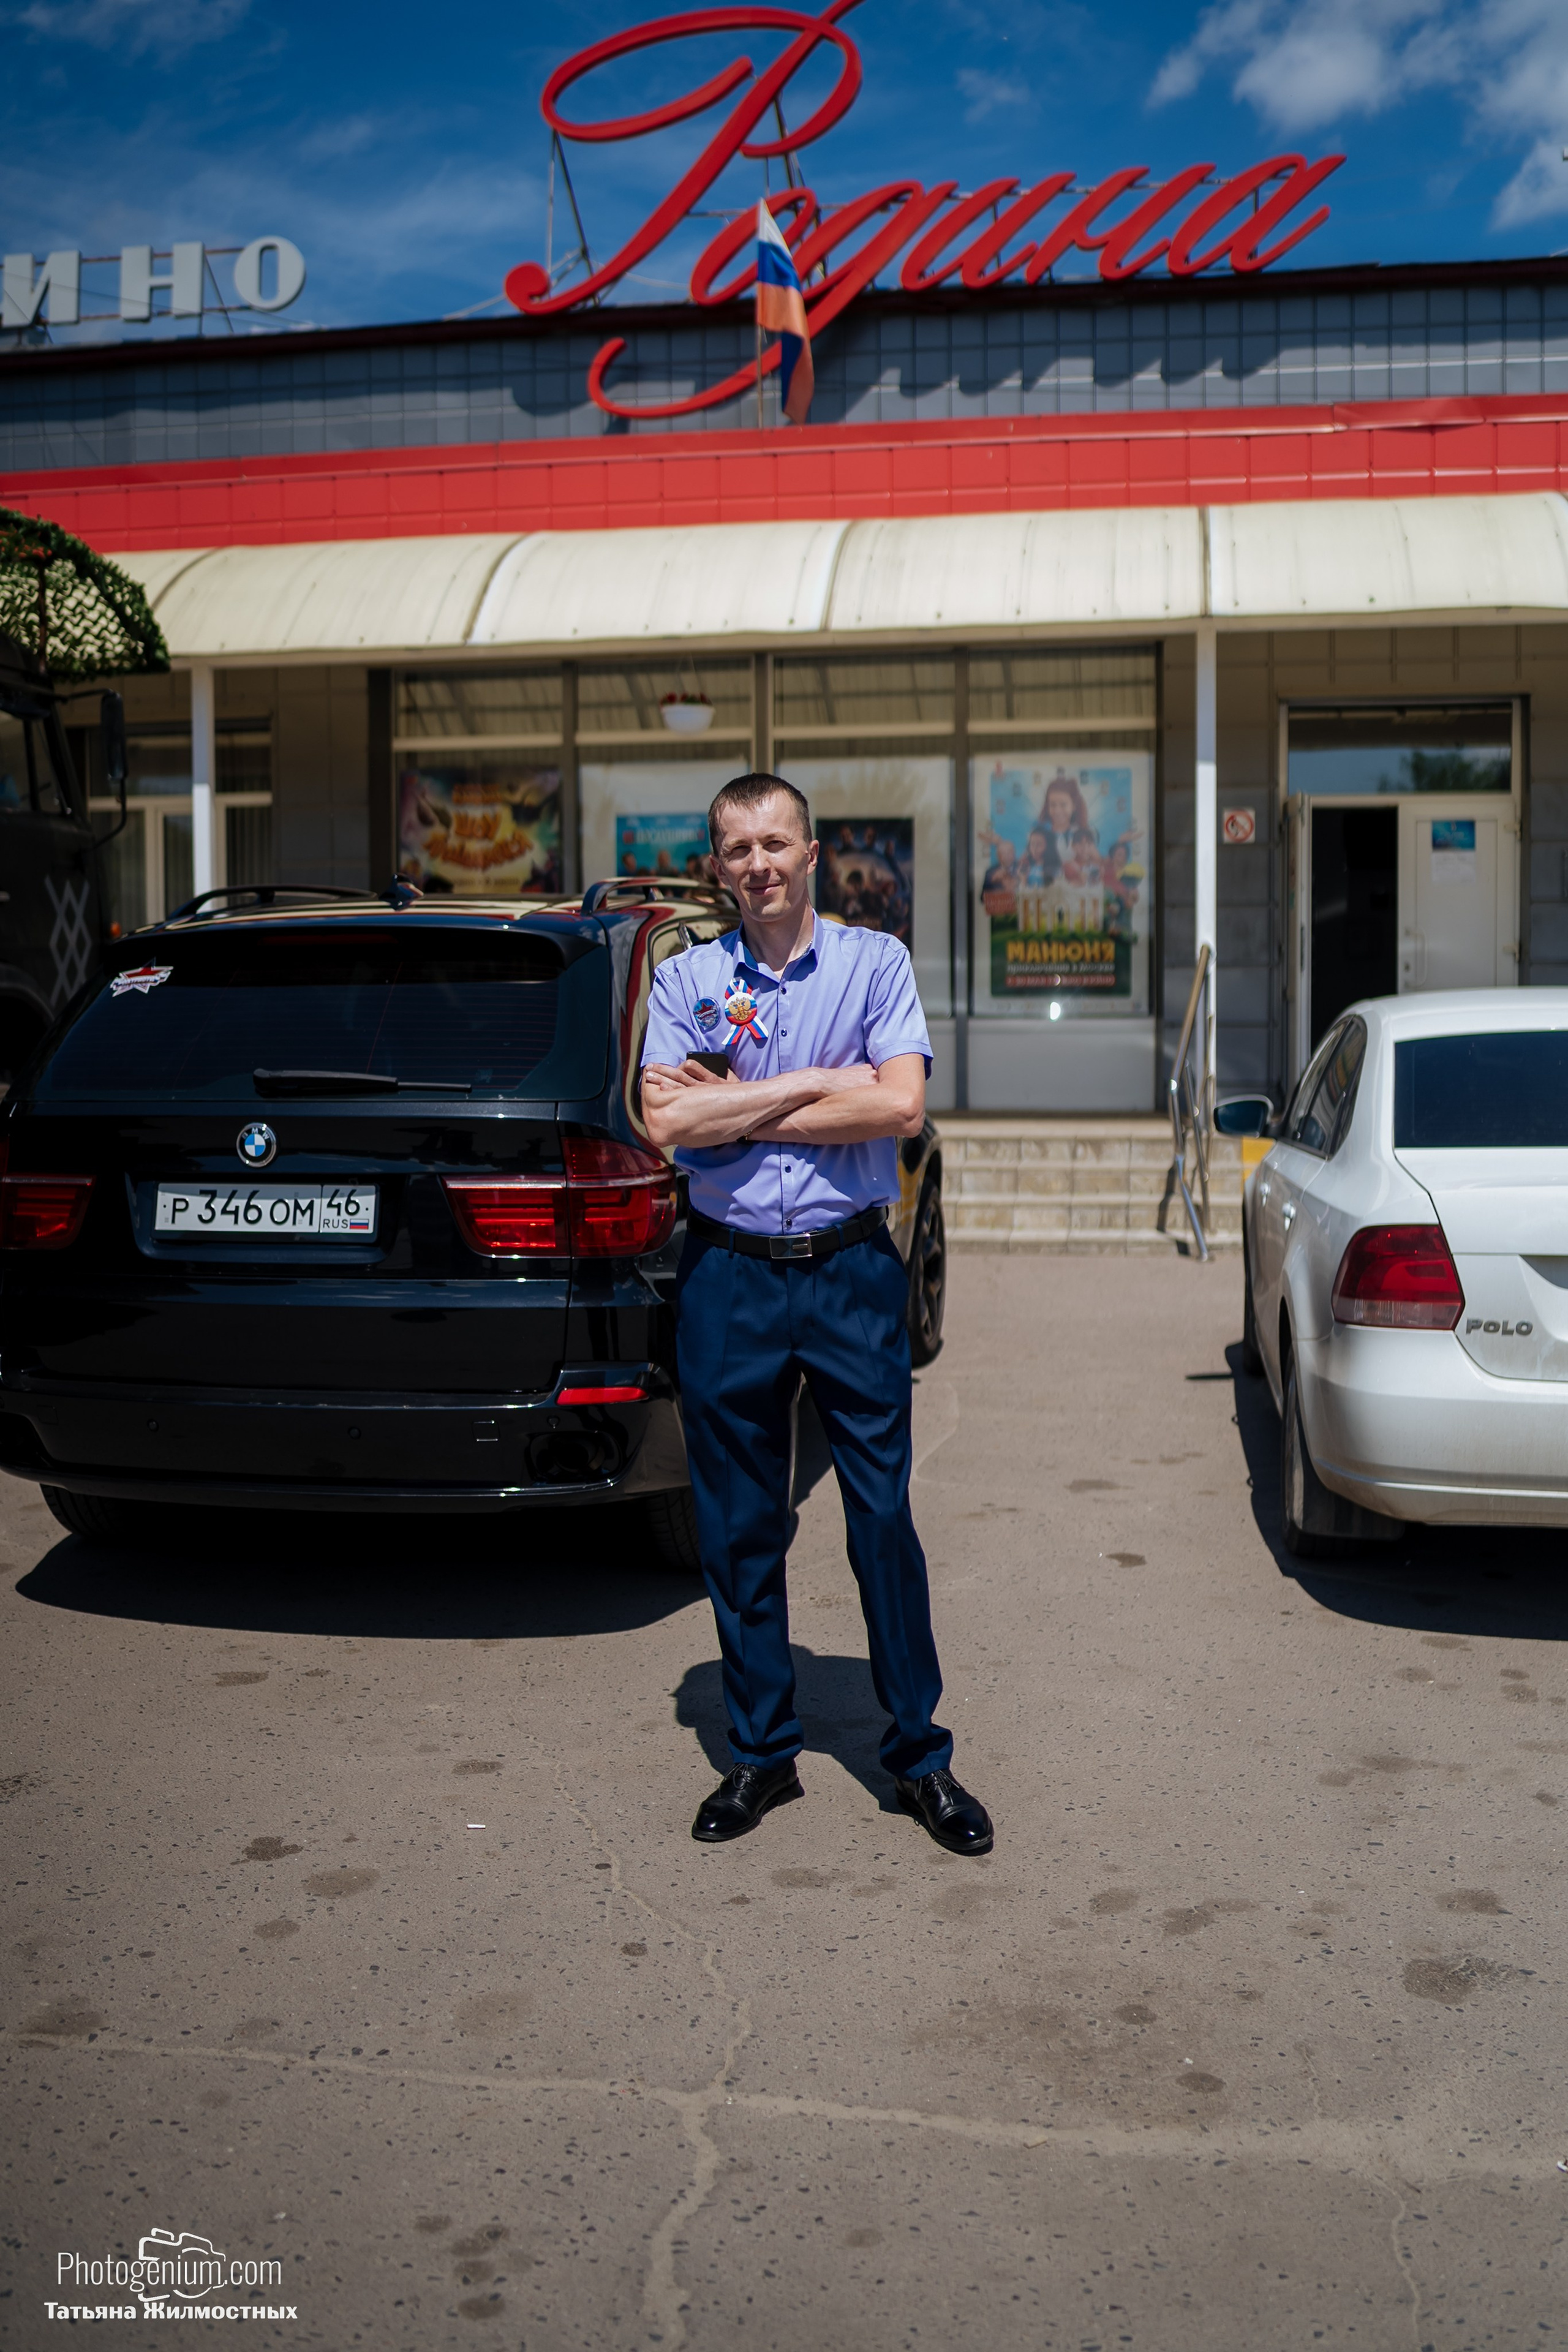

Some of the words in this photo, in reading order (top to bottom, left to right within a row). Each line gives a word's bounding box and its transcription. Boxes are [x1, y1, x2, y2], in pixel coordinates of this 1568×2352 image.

[505, 0, 1347, 418] Родина
[1006, 940, 1115, 963] МАНЮНЯ
[242, 1128, 270, 1140] BMW
[326, 1189, 360, 1216] 46
[323, 1219, 348, 1229] RUS
[1466, 1318, 1533, 1336] POLO
